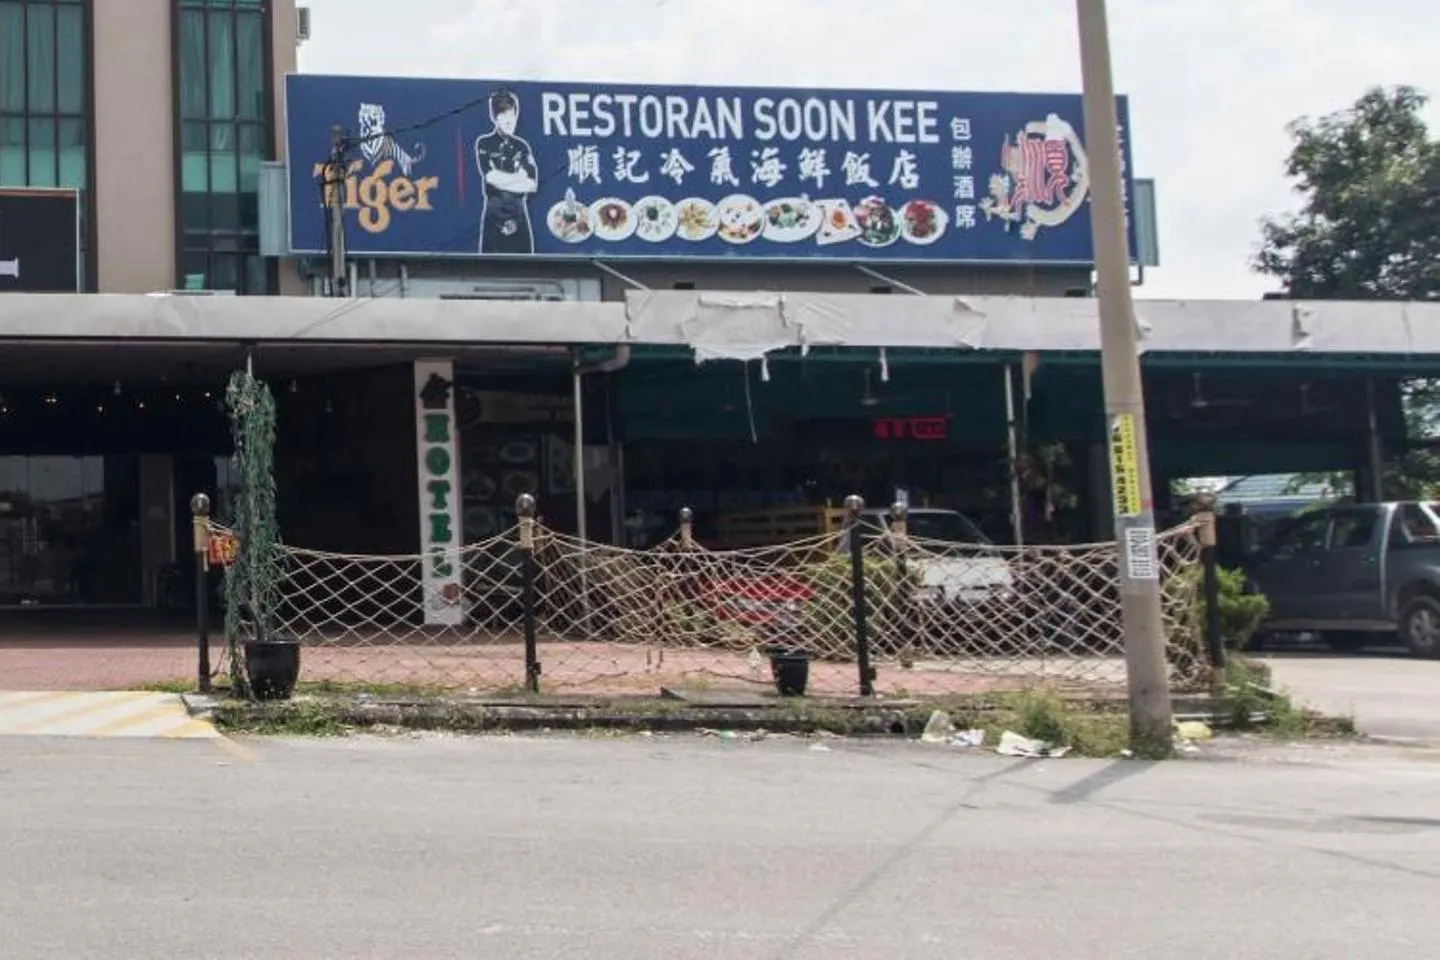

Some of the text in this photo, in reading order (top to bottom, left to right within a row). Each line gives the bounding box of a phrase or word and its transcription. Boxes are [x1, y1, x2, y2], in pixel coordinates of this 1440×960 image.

[541, 91, 940, 144] RESTORAN SOON KEE
[422, 413, 453, 577] HOTEL
